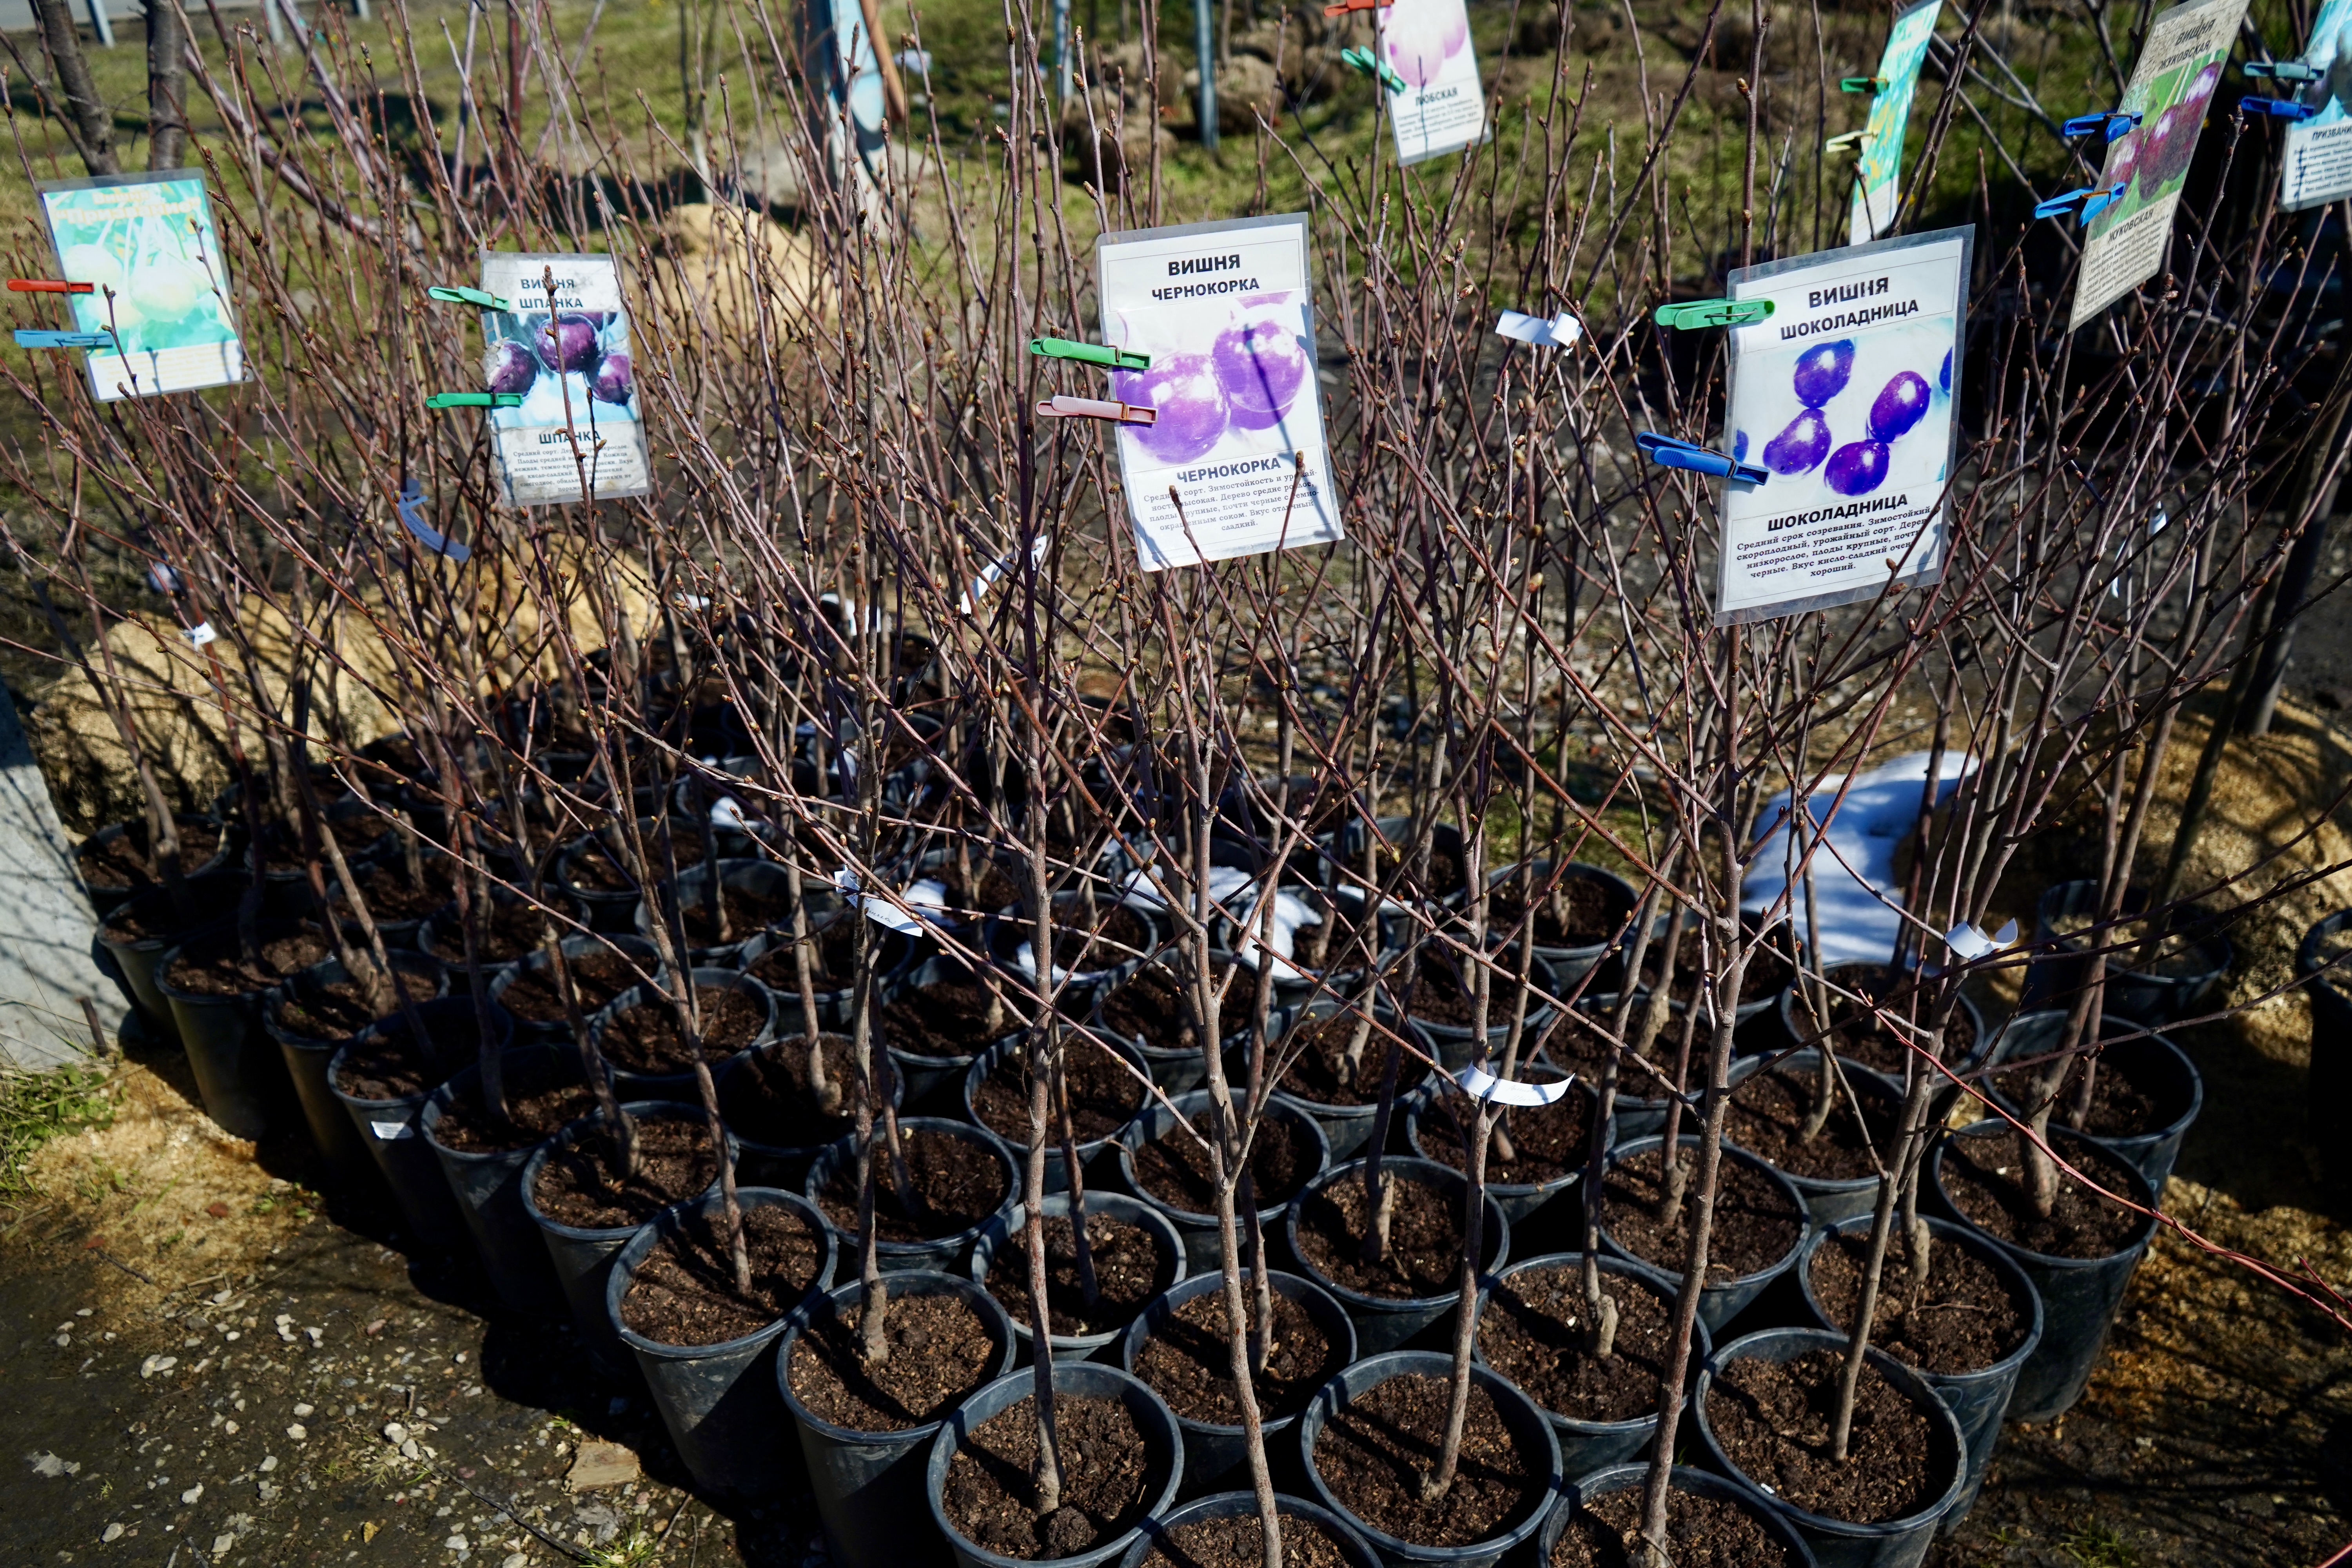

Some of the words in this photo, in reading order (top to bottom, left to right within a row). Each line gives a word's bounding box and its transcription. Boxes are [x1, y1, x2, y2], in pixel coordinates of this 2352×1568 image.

[2175, 19, 2216, 46] ВИШНЯ
[2157, 40, 2211, 71] ЖУКОВСКАЯ
[2109, 209, 2154, 243] ЖУКОВСКАЯ
[1169, 254, 1240, 276] ВИШНЯ
[1152, 278, 1259, 300] ЧЕРНОКОРКА
[1809, 277, 1889, 309] ВИШНЯ
[1780, 299, 1919, 340] ШОКОЛАДНИЦА
[541, 462, 588, 470] темно-красй
[1177, 457, 1281, 483] ЧЕРНОКОРКА
[1144, 490, 1181, 503] Среднй
[1184, 488, 1206, 496] сорт.
[1209, 477, 1274, 492] Зимостойкость
[1284, 469, 1317, 482] урай-
[1221, 491, 1250, 501] Дерево
[1253, 486, 1281, 496] средне
[1284, 481, 1314, 492] ролое,
[1149, 513, 1177, 522] плоды
[1183, 506, 1220, 517] рупные,
[1250, 496, 1282, 506] черные
[1219, 512, 1247, 521] соком.
[1250, 507, 1270, 516] Вкус
[1768, 494, 1908, 532] ШОКОЛАДНИЦА
[1221, 519, 1258, 531] сладкий.
[1737, 536, 1779, 551] Средний
[1782, 533, 1804, 542] срок
[1807, 522, 1864, 537] созревания.
[1868, 506, 1931, 526] Зимостойкий
[1737, 540, 1810, 561] скороплодный,
[1813, 529, 1870, 547] урожайный
[1873, 526, 1896, 535] сорт.
[1899, 518, 1928, 530] Дерев
[1747, 553, 1808, 569] низкорослое,
[1812, 545, 1843, 556] плоды
[1846, 537, 1891, 550] крупные,
[1750, 567, 1788, 578] черные.
[1792, 561, 1814, 570] Вкус
[1818, 546, 1887, 565] кисло-сладкий
[1890, 542, 1912, 551] очен
[1810, 562, 1856, 577] хороший.
